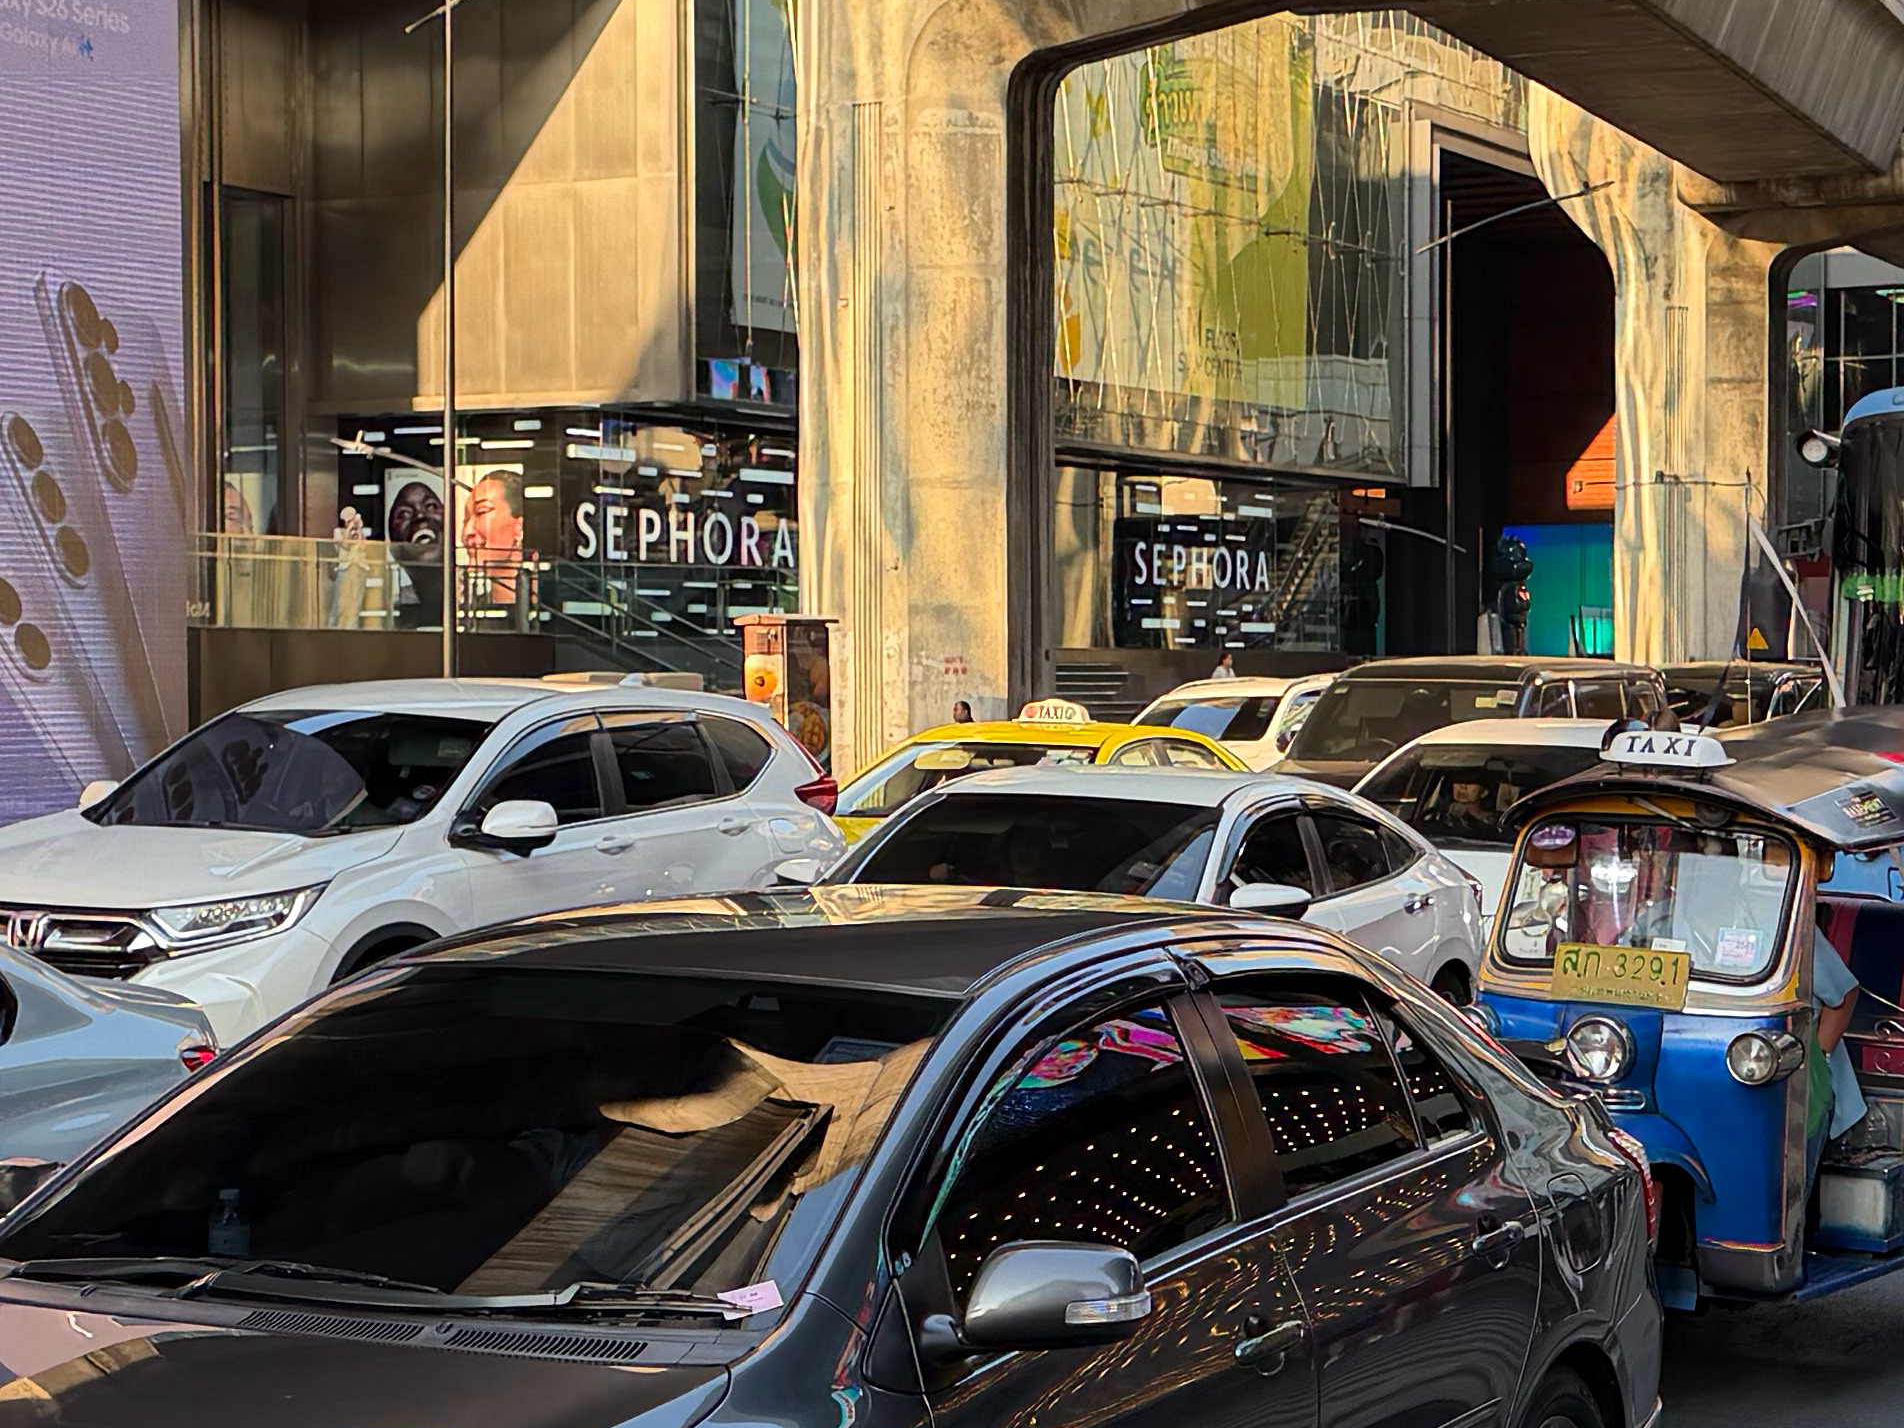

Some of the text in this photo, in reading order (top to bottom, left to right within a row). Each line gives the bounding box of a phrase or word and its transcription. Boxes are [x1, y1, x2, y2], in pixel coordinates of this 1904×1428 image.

[576, 502, 794, 567] SEPHORA
[1134, 541, 1269, 592] SEPHORA
[1038, 704, 1063, 719] TAXI
[1626, 734, 1696, 757] TAXI
